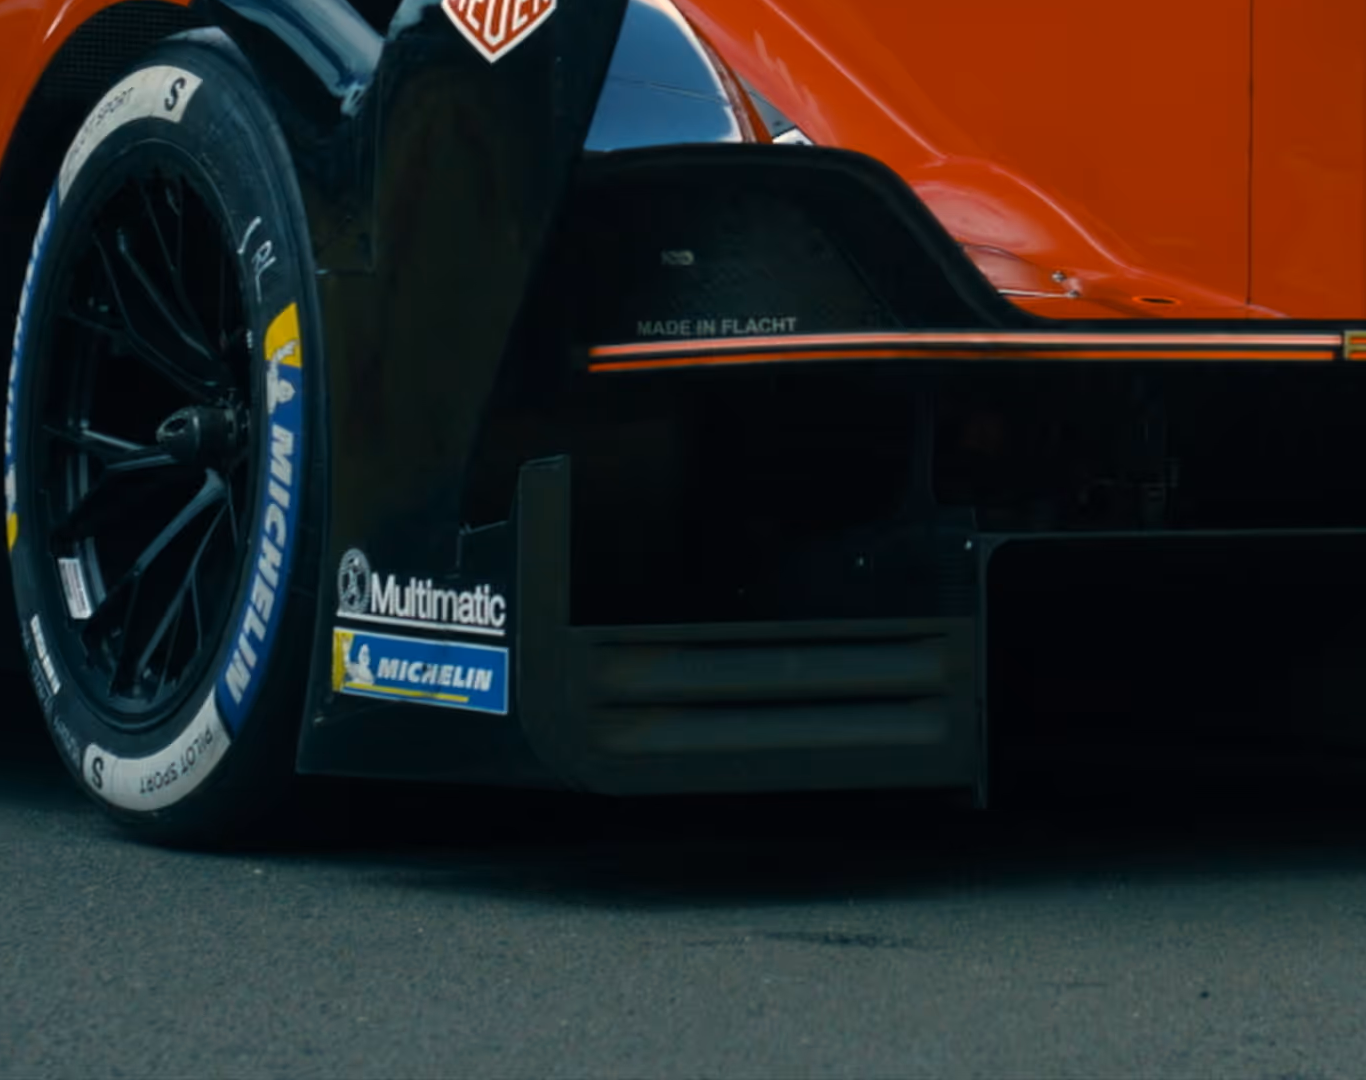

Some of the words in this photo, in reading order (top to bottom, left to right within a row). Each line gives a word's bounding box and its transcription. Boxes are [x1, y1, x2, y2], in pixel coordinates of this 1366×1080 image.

[637, 320, 691, 336] MADE
[697, 319, 716, 335] IN
[721, 317, 797, 334] FLACHT
[225, 424, 295, 705] MICHELIN
[370, 572, 506, 628] Multimatic
[377, 657, 494, 692] MICHELIN
